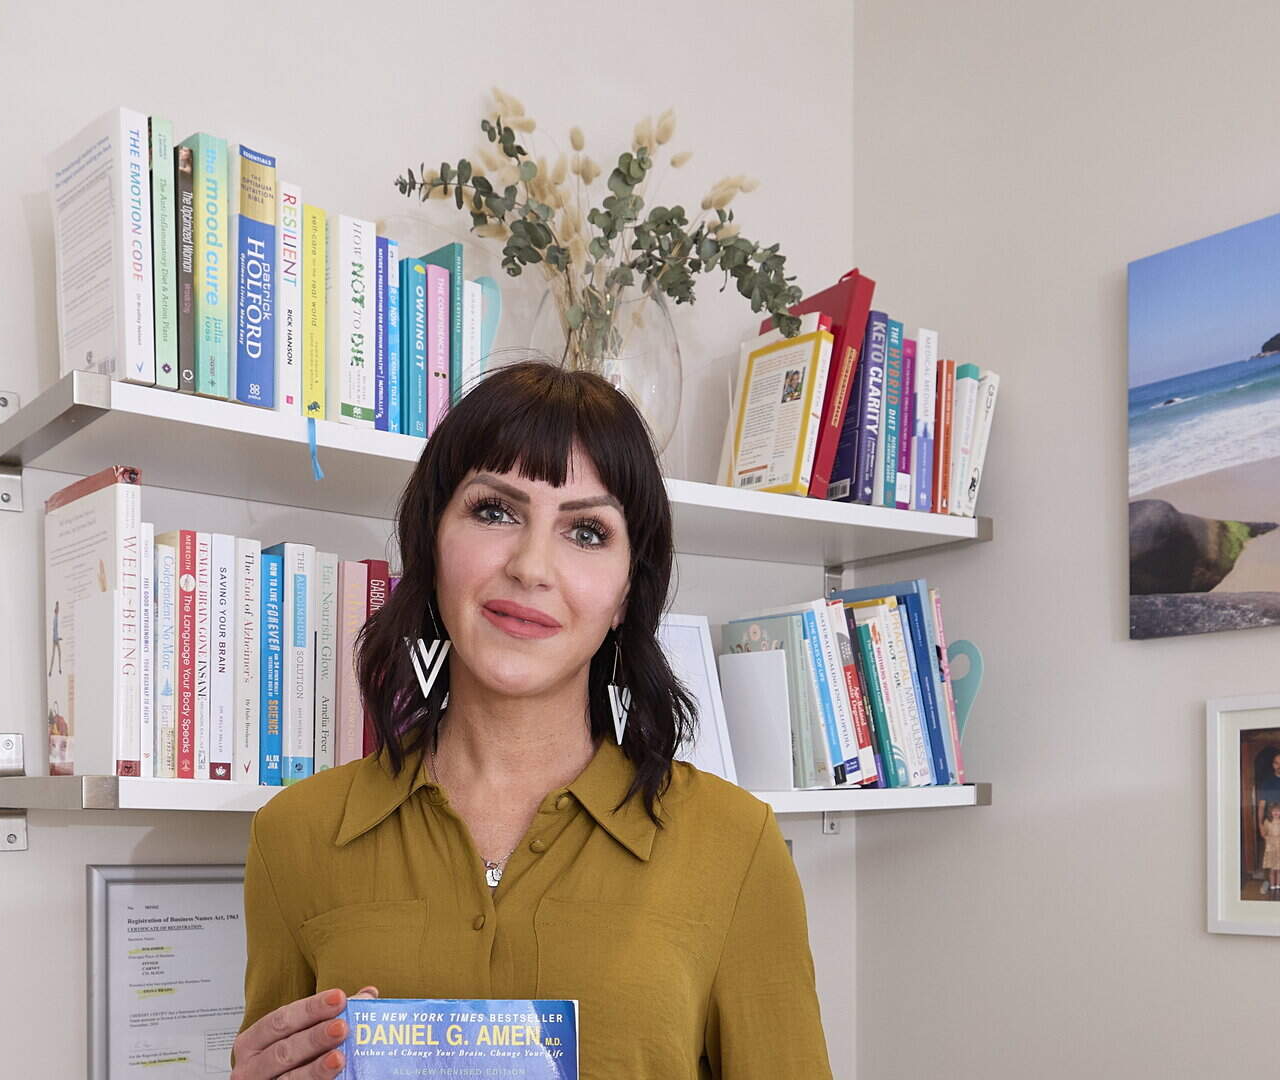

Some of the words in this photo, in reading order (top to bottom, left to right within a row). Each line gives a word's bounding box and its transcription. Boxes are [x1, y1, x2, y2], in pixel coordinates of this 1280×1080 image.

[129, 129, 140, 157] THE
[243, 150, 272, 166] ESSENTIALS
[206, 148, 216, 174] the
[130, 162, 143, 235] EMOTION
[183, 192, 193, 205] The
[241, 183, 274, 199] NUTRITION
[242, 176, 272, 191] OPTIMUM
[206, 178, 223, 248] mood
[248, 194, 264, 204] BIBLE
[182, 206, 193, 243] Optimized
[352, 222, 362, 255] HOW
[283, 193, 297, 287] RESILIENT
[132, 239, 144, 281] CODE
[183, 244, 194, 273] Woman
[206, 250, 219, 305] cure
[262, 262, 273, 320] patrick
[351, 262, 366, 309] NOT
[246, 236, 265, 359] HOLFORD
[352, 310, 362, 330] TO
[416, 286, 424, 350] OWNING
[872, 321, 887, 362] KETO
[890, 326, 899, 345] THE
[350, 333, 365, 369] DIE
[416, 355, 424, 370] IT
[888, 347, 901, 405] HYBRID
[865, 366, 882, 435] CLARITY
[888, 408, 896, 431] DIET
[184, 533, 192, 571] MEREDITH
[244, 552, 255, 574] The
[297, 552, 305, 570] THE
[270, 562, 279, 577] HOW
[270, 578, 279, 587] TO
[161, 555, 174, 619] Codependent
[218, 567, 227, 605] SAVING
[244, 577, 255, 601] End
[270, 587, 279, 602] LIVE
[184, 595, 193, 611] The
[198, 590, 208, 624] BRAIN
[244, 603, 255, 616] of
[162, 624, 174, 640] No
[218, 609, 227, 639] YOUR
[266, 603, 280, 652] FOREVER
[181, 614, 193, 666] Language
[198, 627, 208, 658] GONE
[243, 619, 254, 683] Alzheimer's
[162, 642, 174, 671] More
[218, 641, 227, 674] BRAIN
[183, 668, 192, 689] Your
[198, 659, 208, 699] INSANE
[296, 650, 305, 699] SOLUTION
[181, 690, 192, 717] Body
[268, 700, 279, 735] SCIENCE
[320, 695, 330, 728] Amelia
[181, 718, 192, 754] Speaks
[320, 729, 330, 754] Freer
[354, 1012, 377, 1021] THE
[382, 1012, 408, 1022] NEW
[413, 1013, 444, 1022] YORK
[450, 1013, 484, 1023] TIMES
[489, 1014, 563, 1023] BESTSELLER
[356, 1024, 439, 1045] DANIEL
[446, 1024, 469, 1046] G.
[545, 1037, 562, 1046] M.D.
[354, 1049, 385, 1057] Author
[388, 1049, 397, 1057] of
[401, 1049, 433, 1058] Change
[436, 1049, 455, 1057] Your
[490, 1049, 521, 1058] Change
[524, 1049, 544, 1057] Your
[548, 1050, 564, 1058] Life
